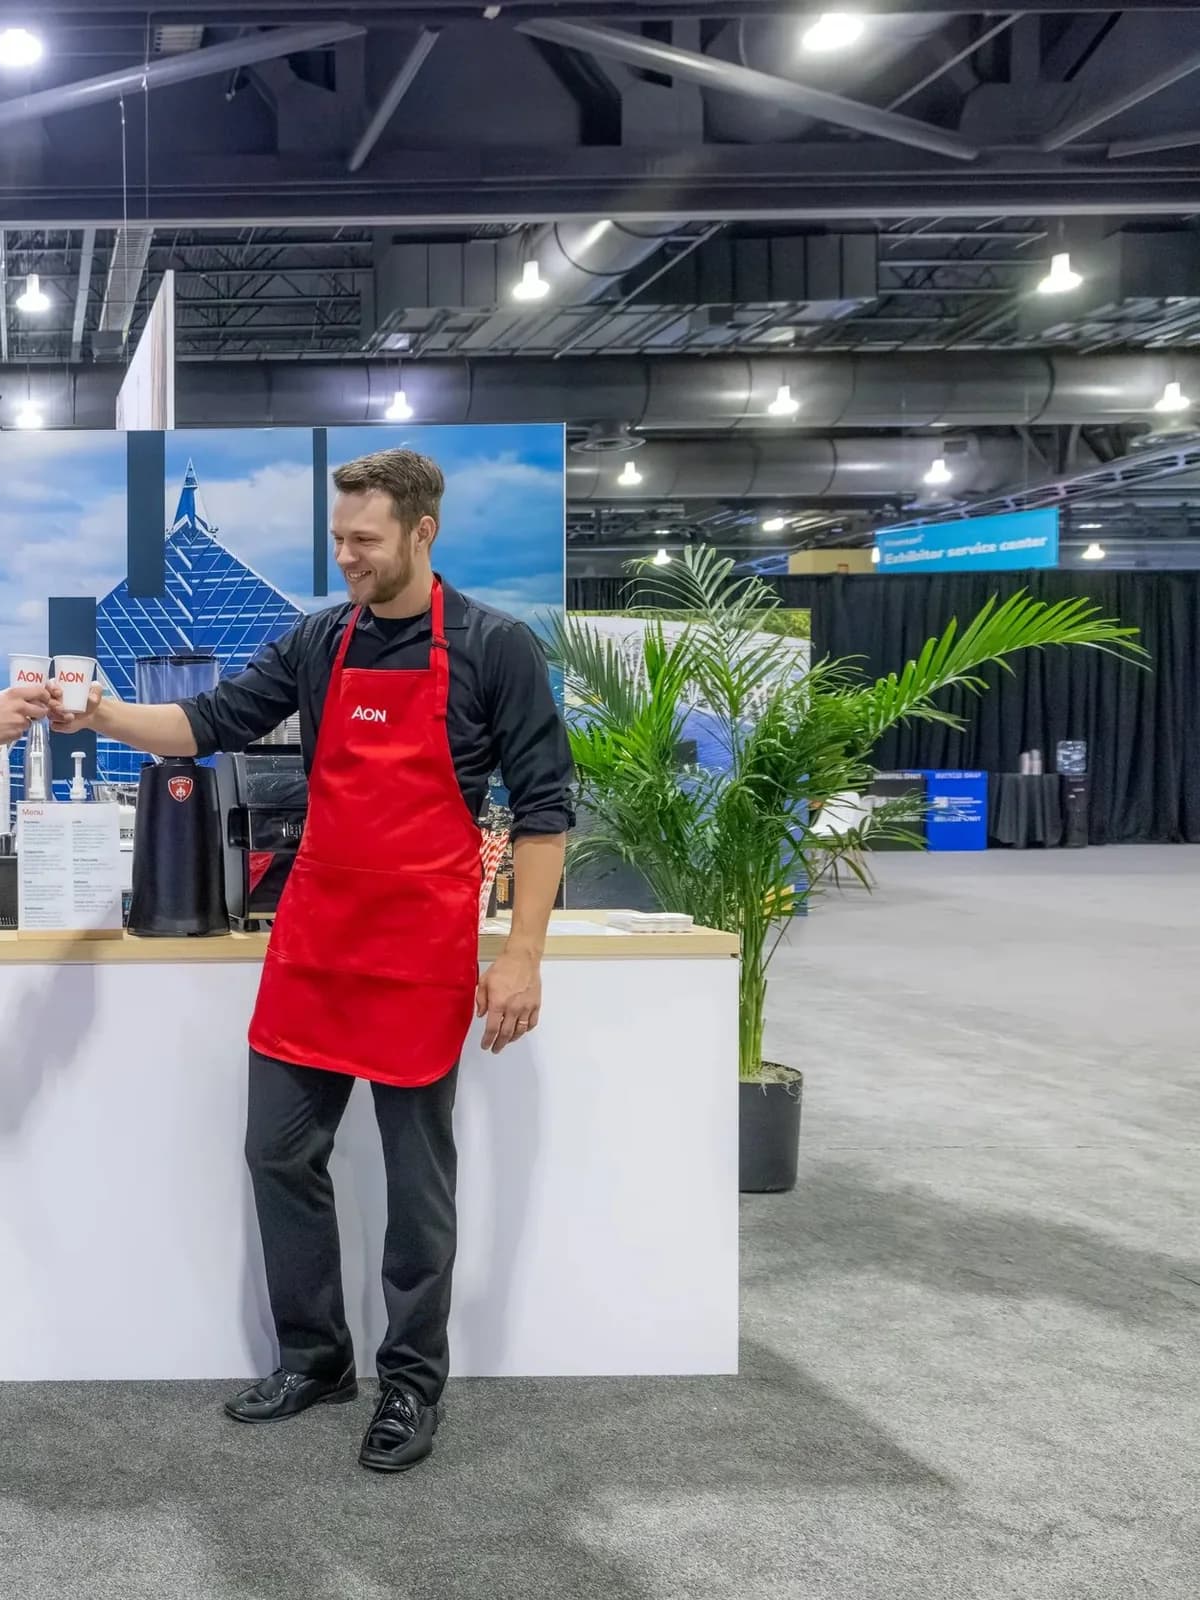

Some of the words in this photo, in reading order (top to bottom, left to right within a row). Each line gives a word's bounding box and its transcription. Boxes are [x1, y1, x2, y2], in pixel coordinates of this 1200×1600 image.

[947, 541, 997, 558] service
[16, 669, 44, 684] AON
[59, 671, 85, 684] AON
[351, 704, 387, 723] AON
[22, 808, 44, 816] Menu
